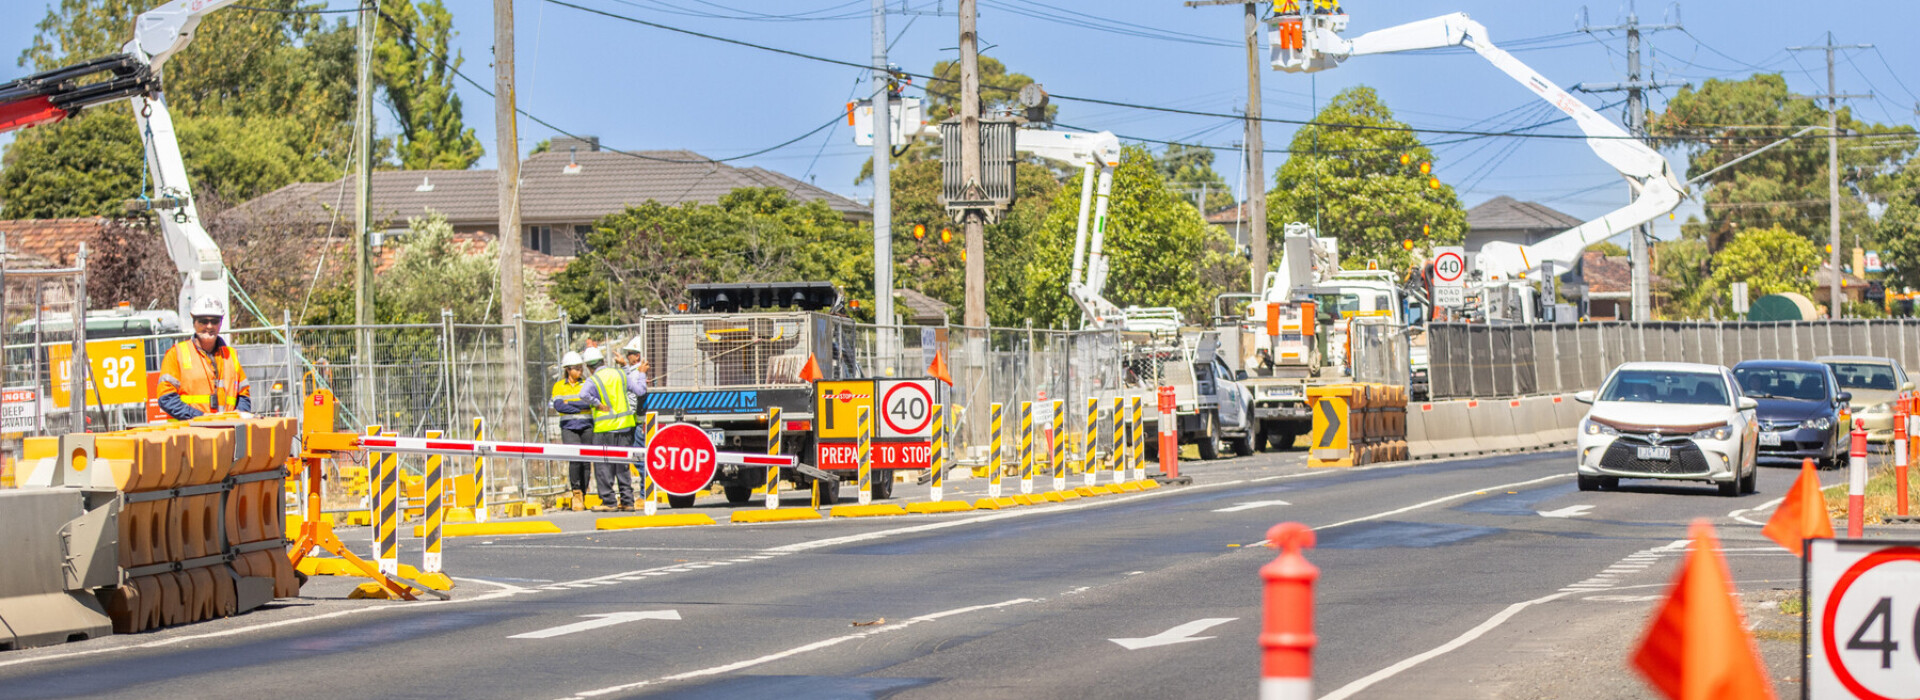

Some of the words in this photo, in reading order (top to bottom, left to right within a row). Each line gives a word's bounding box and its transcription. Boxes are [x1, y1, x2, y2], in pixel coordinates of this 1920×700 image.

[1439, 260, 1459, 273] 40
[102, 355, 137, 389] 32
[891, 397, 925, 420] 40
[652, 445, 710, 473] STOP
[821, 446, 874, 464] PREPAE
[881, 446, 896, 464] TO
[902, 446, 931, 464] STOP
[1846, 596, 1920, 669] 4
